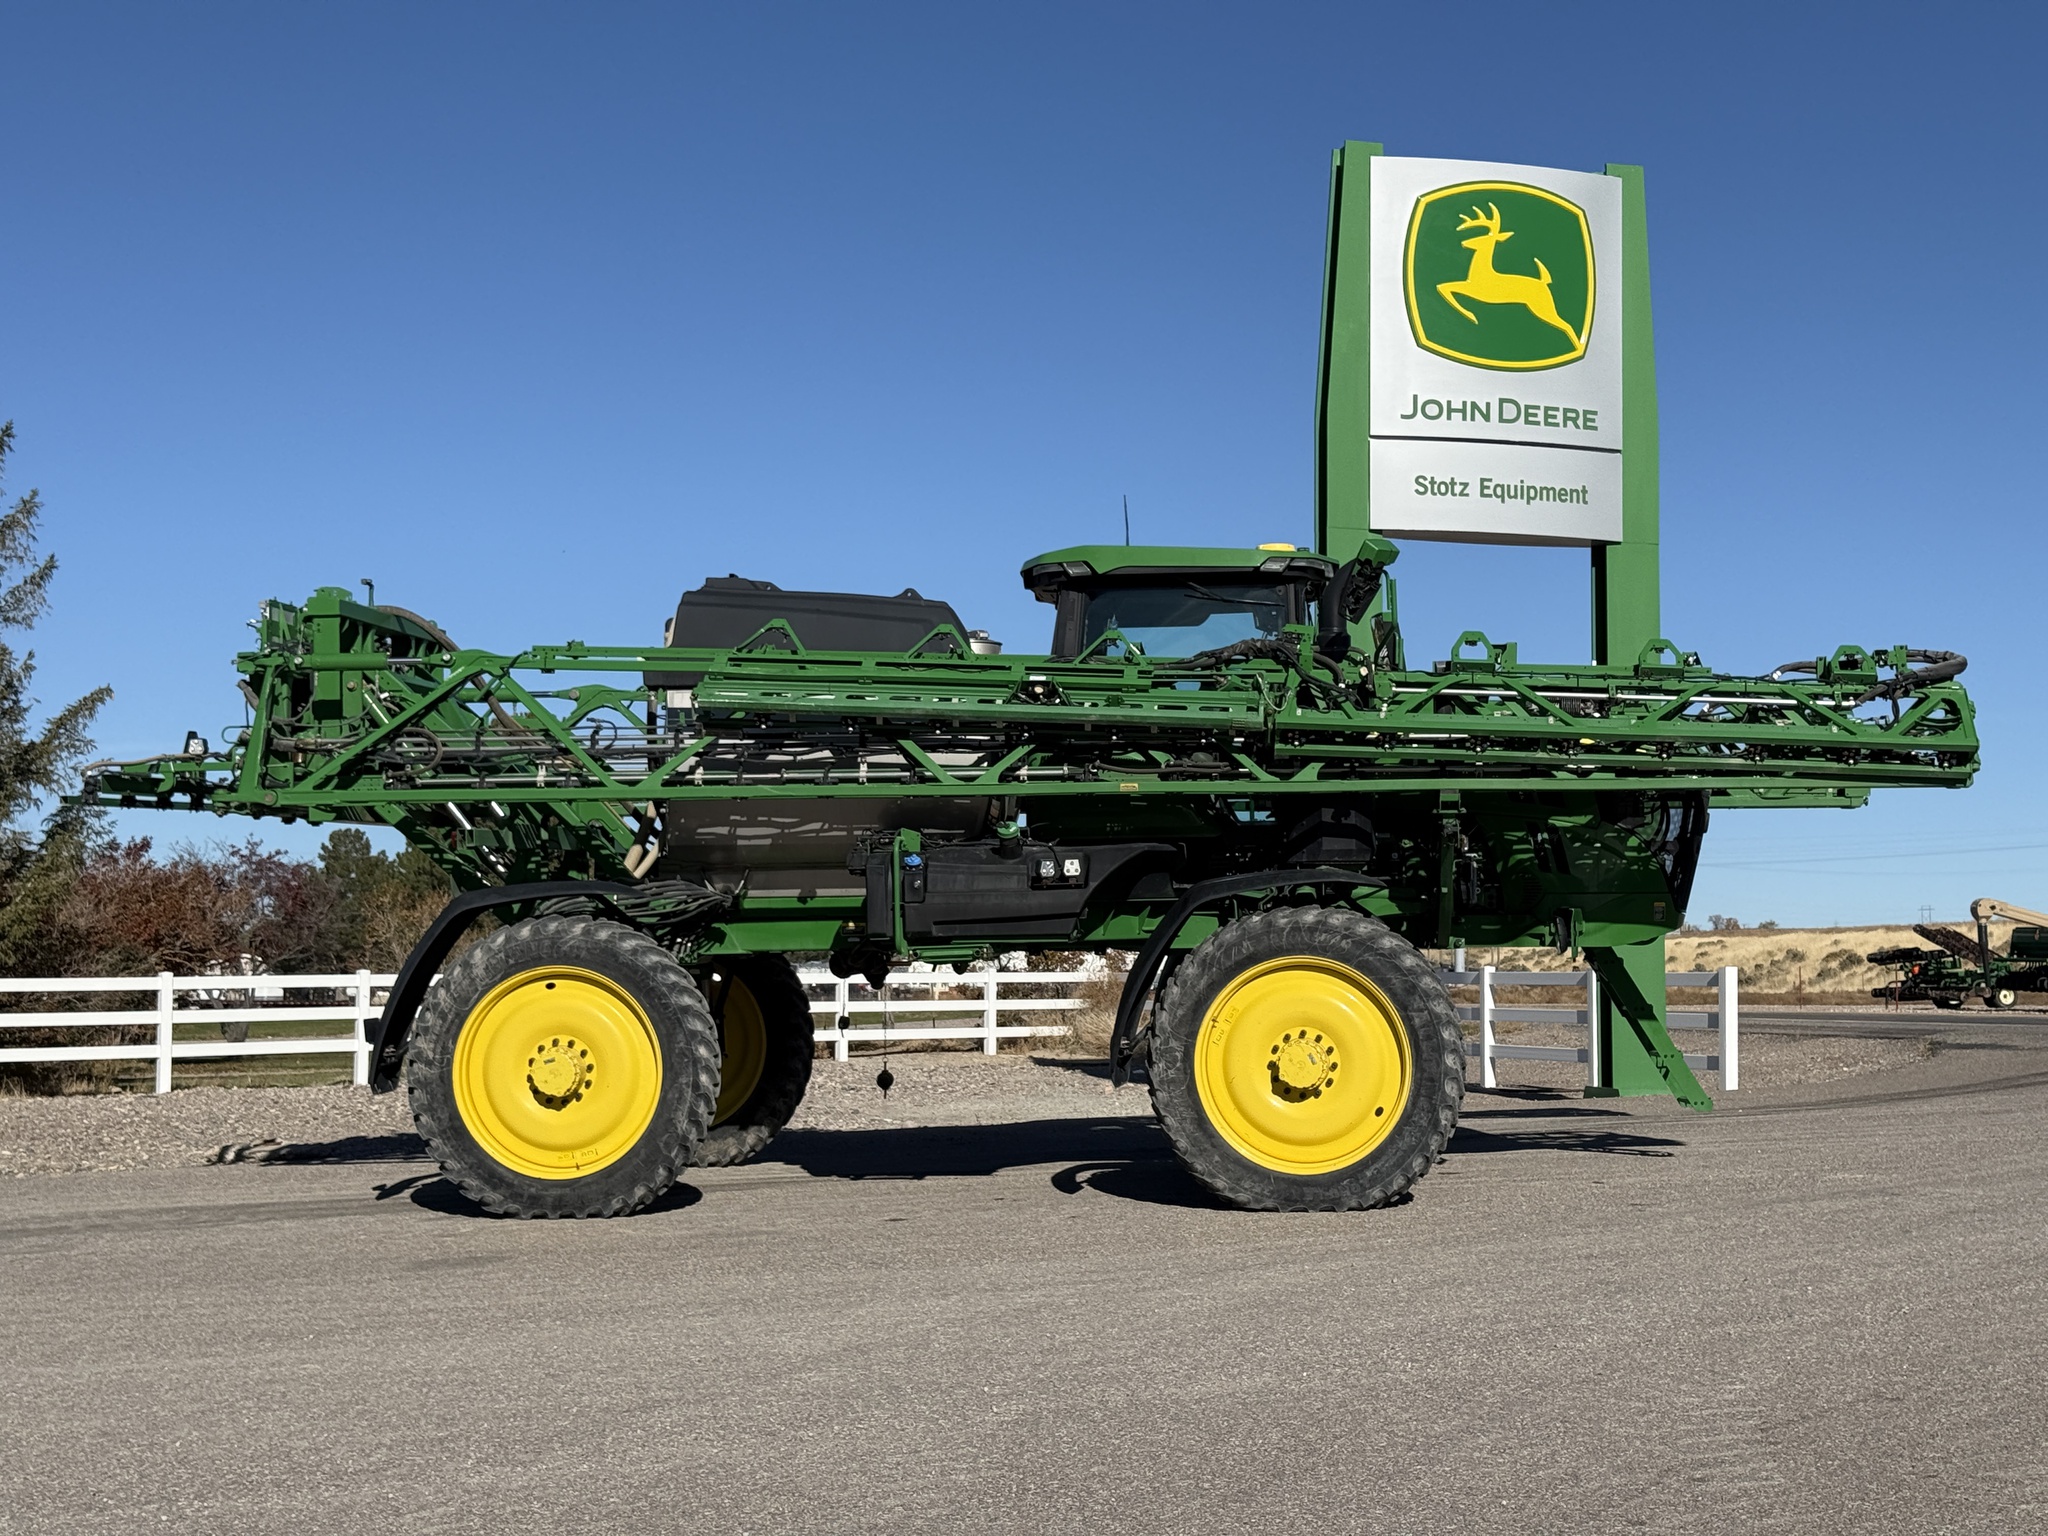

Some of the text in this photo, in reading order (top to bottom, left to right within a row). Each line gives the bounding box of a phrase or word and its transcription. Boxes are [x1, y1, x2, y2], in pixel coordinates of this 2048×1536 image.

[1400, 394, 1599, 432] JOHN DEERE
[1414, 475, 1589, 505] Stotz Equipment
